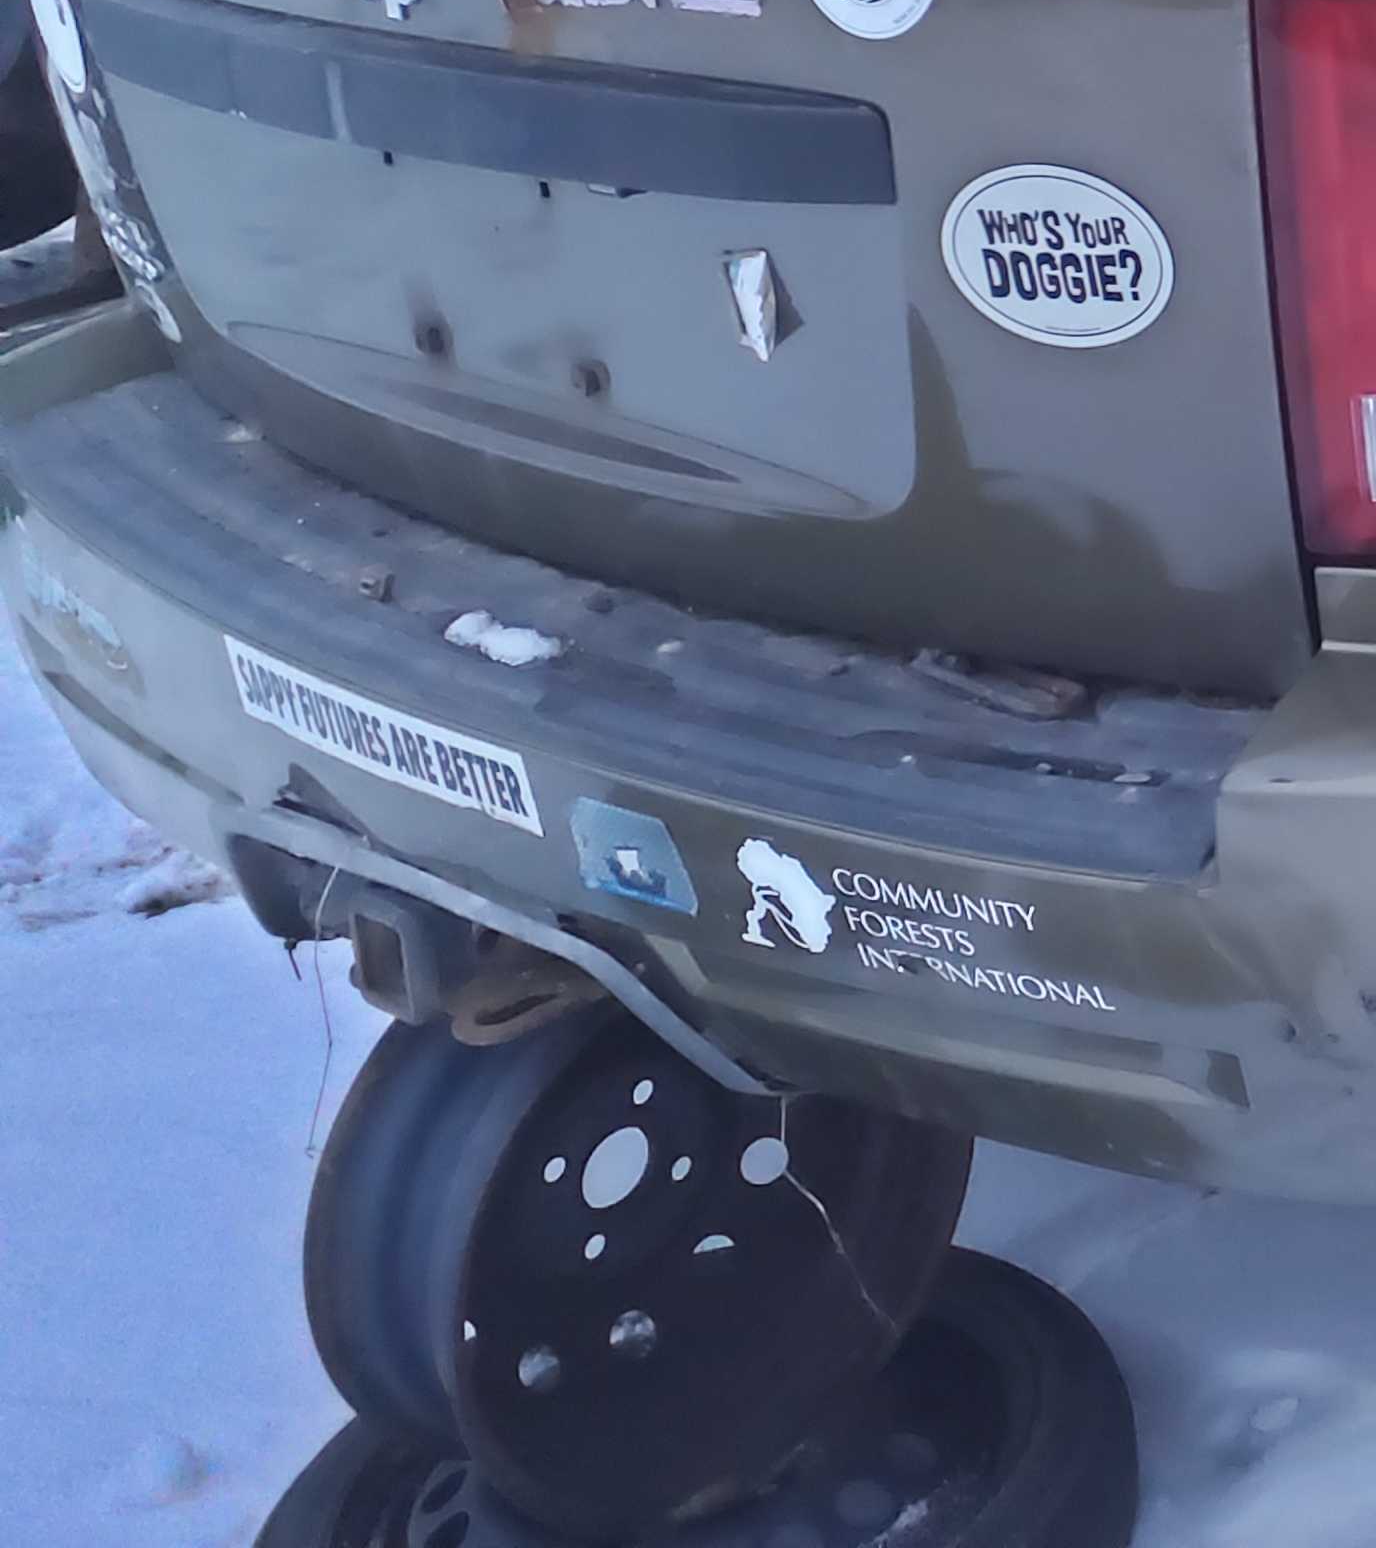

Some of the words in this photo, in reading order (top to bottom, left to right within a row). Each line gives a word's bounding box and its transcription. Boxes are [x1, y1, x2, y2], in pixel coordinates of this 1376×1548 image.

[976, 208, 1065, 251] WHO'S
[1063, 212, 1131, 249] YOUR
[981, 248, 1143, 304] DOGGIE?
[236, 653, 301, 727] SAPPY
[294, 683, 392, 768] FUTURES
[387, 722, 441, 788] ARE
[431, 739, 530, 819] BETTER
[832, 868, 1036, 932] COMMUNITY
[843, 905, 976, 957] FORESTS
[856, 942, 1117, 1012] INRNATIONAL
